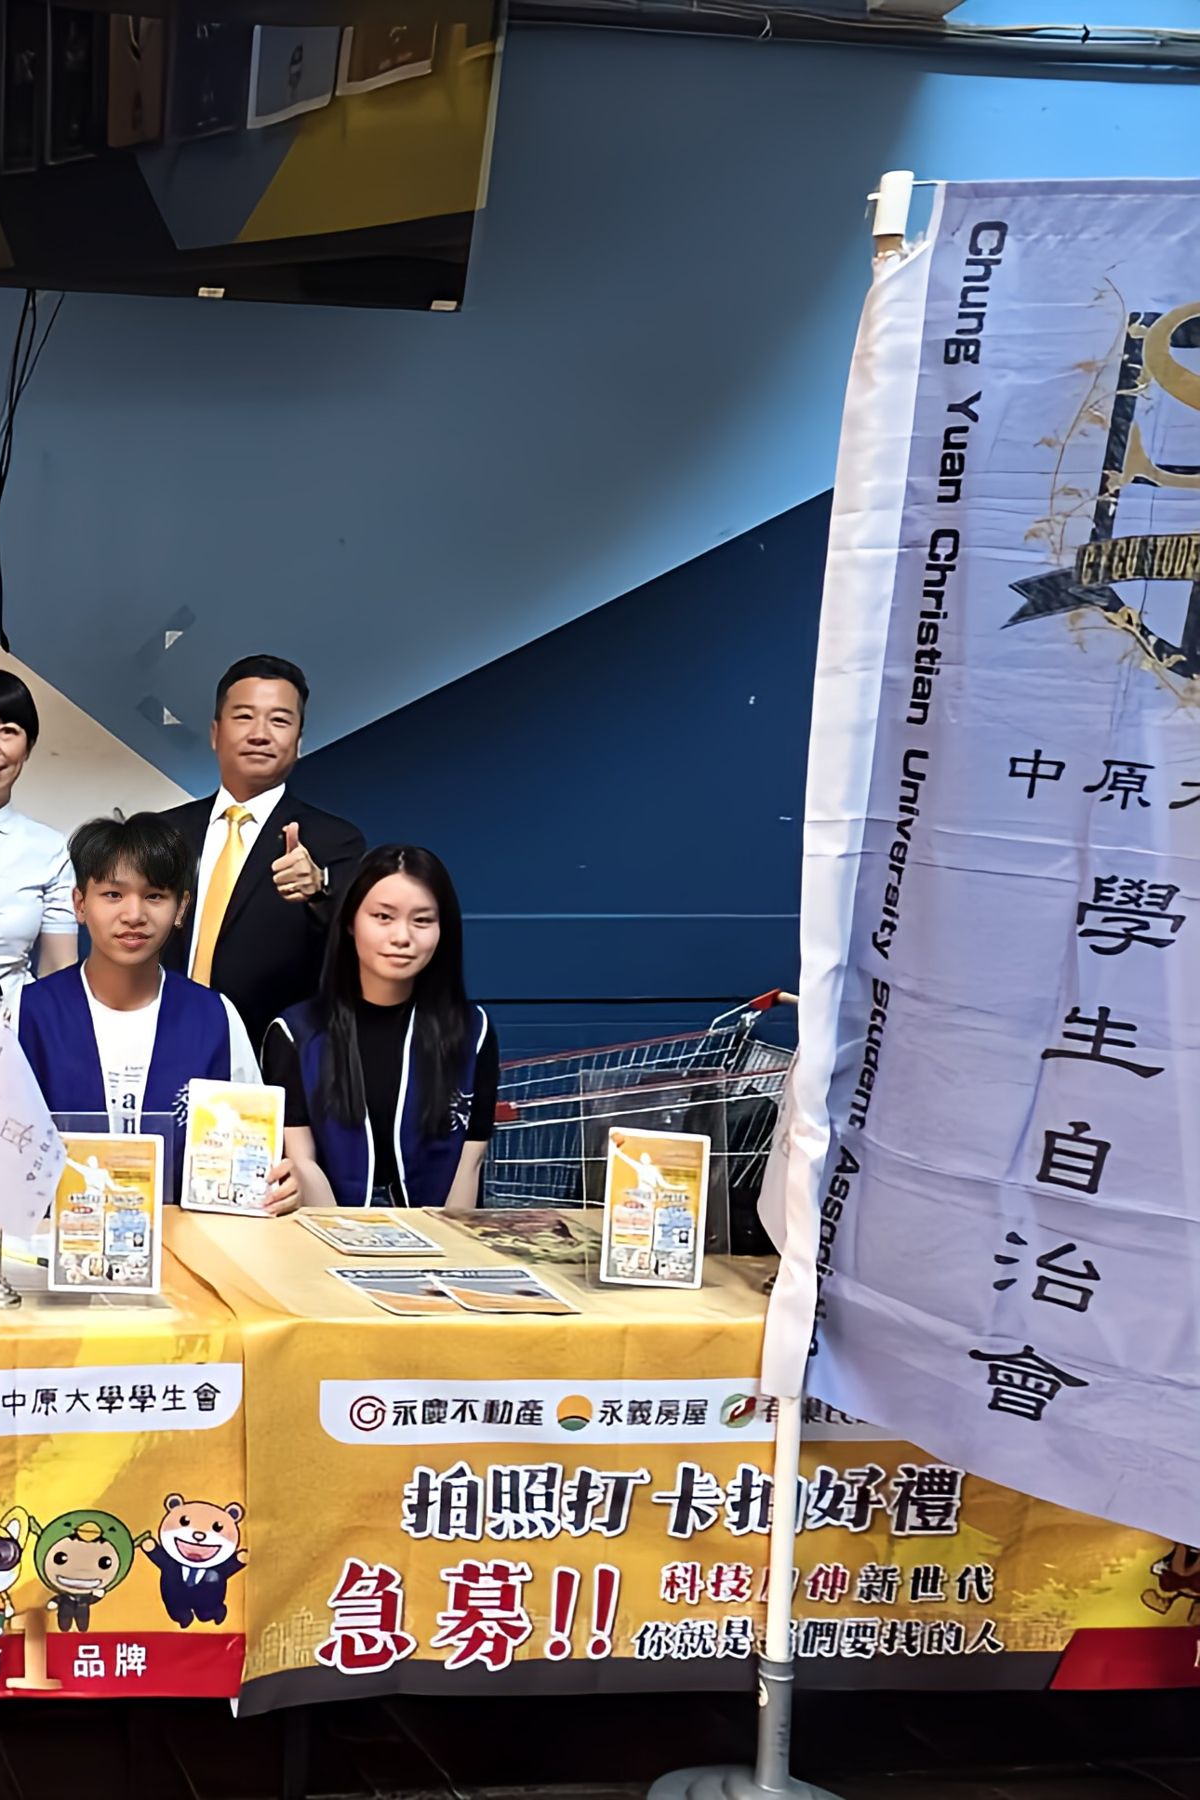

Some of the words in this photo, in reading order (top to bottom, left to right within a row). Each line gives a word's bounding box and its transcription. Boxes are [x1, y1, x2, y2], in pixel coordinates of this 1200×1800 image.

[943, 219, 1009, 365] Chung
[937, 391, 982, 504] Yuan
[906, 529, 961, 726] Christian
[872, 749, 930, 960] University
[848, 979, 891, 1130] Student
[969, 875, 1186, 1421] 學生自治會
[2, 1382, 221, 1415] 中原大學學生會
[393, 1399, 543, 1428] 永慶不動產
[598, 1399, 709, 1426] 永義房屋
[632, 1617, 1004, 1659] 你就是們要找的人
[661, 1562, 994, 1603] 科技仲新世代
